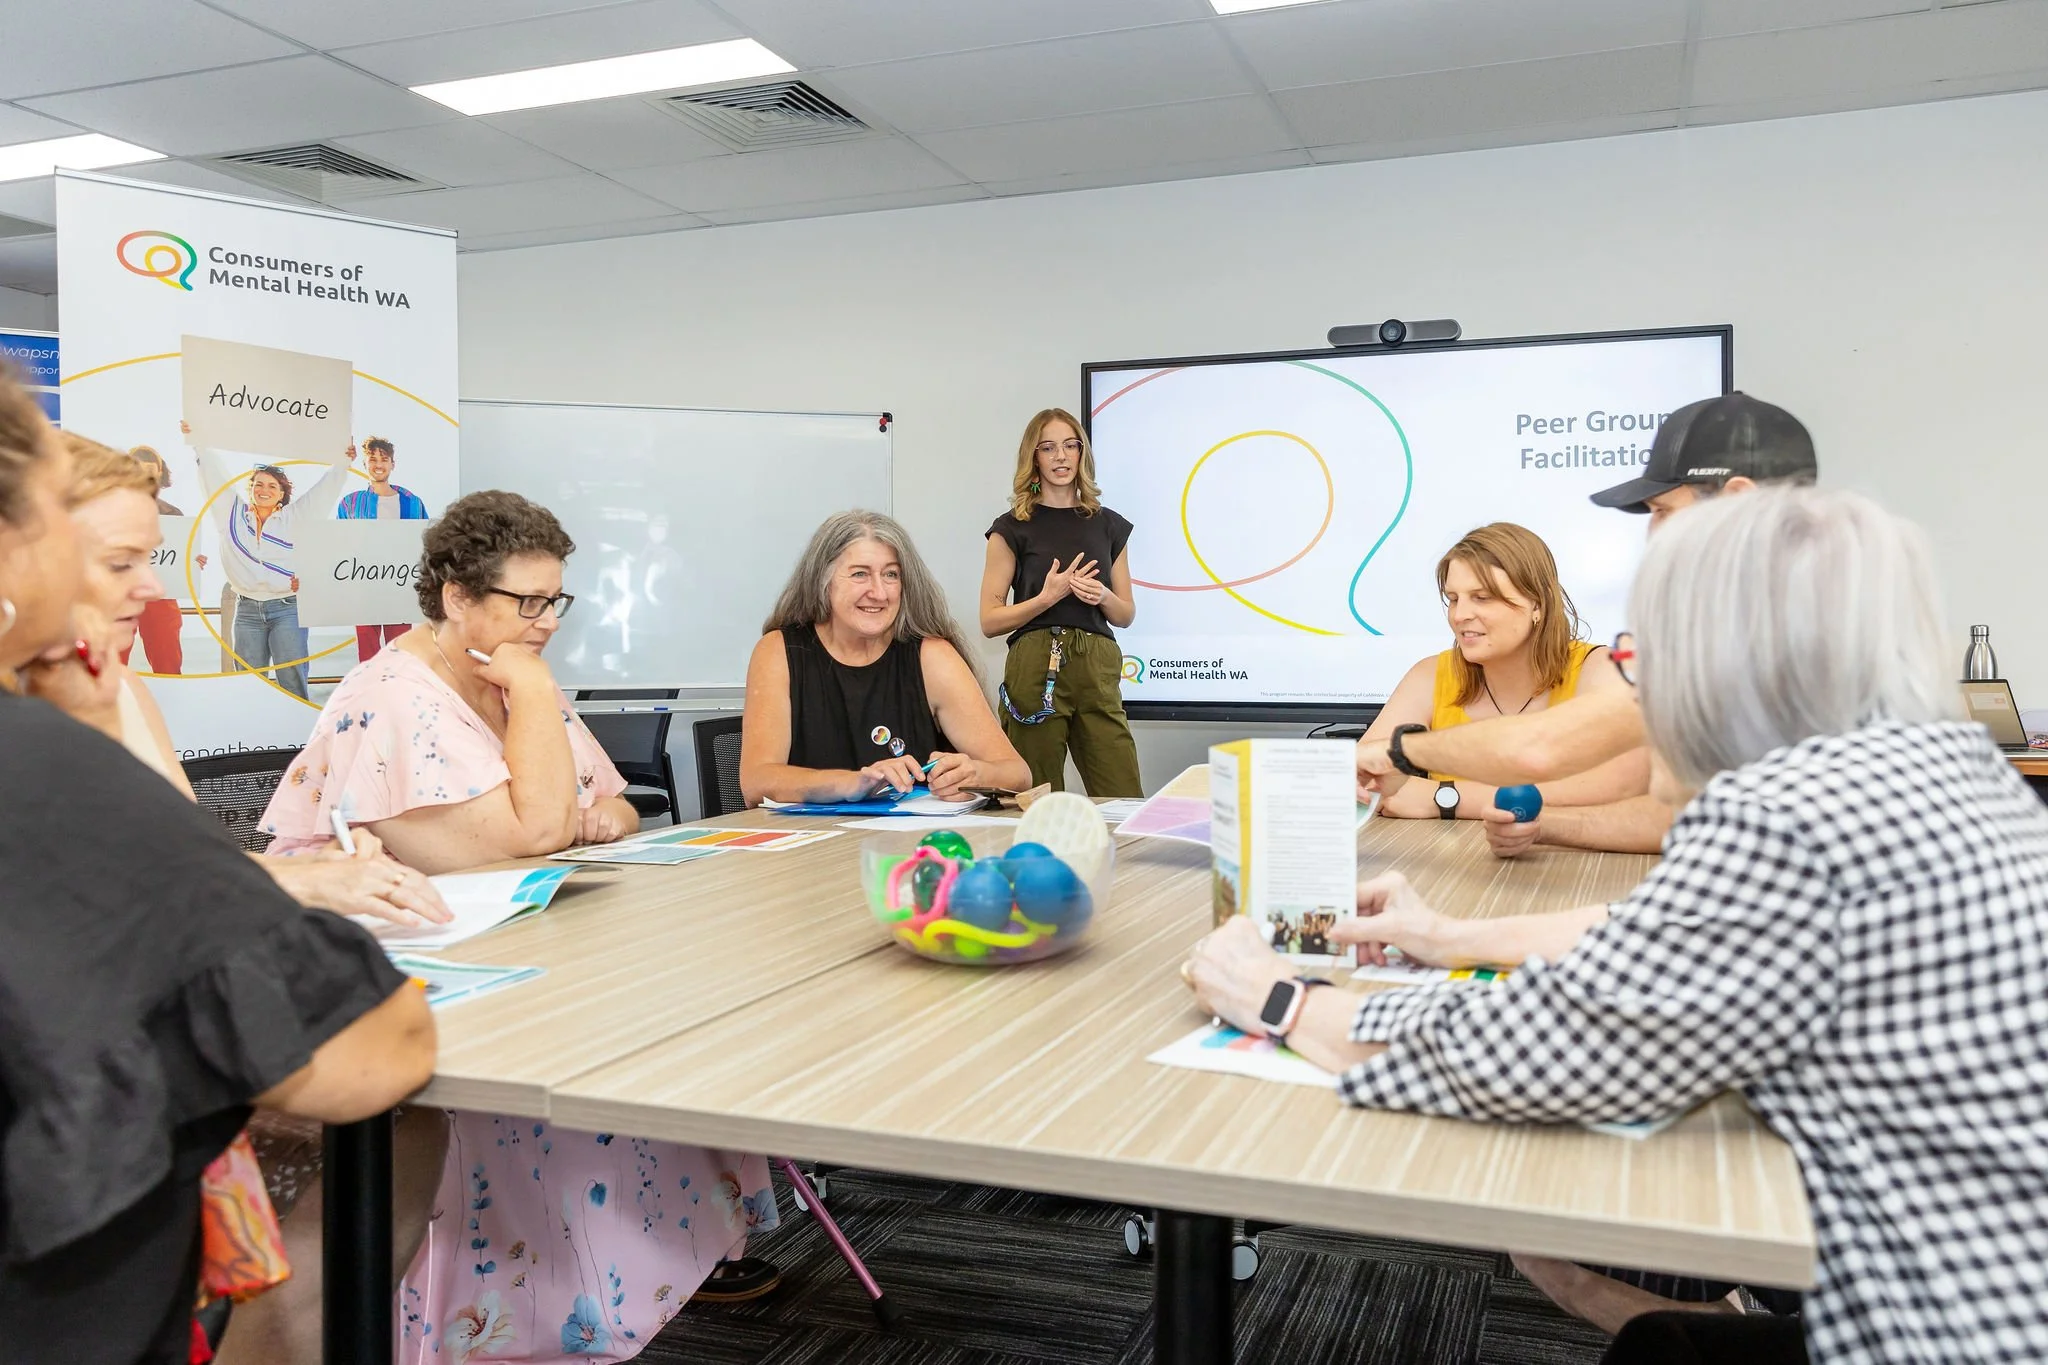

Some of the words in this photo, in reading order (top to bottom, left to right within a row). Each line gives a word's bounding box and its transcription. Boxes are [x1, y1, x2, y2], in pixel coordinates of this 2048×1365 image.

[208, 246, 334, 278] Consumers
[340, 265, 363, 282] of
[208, 268, 290, 294] Mental
[297, 279, 369, 304] Health
[375, 290, 411, 309] WA
[208, 383, 329, 419] Advocate
[1516, 412, 1577, 435] Peer
[1521, 443, 1652, 469] Facilitatio
[1687, 467, 1731, 476] FLEXFIT
[334, 557, 420, 587] Change
[1149, 659, 1208, 668] Consumers
[1211, 658, 1224, 668] of
[1149, 670, 1187, 680] Mental
[1190, 670, 1226, 680] Health
[1229, 671, 1248, 680] WA
